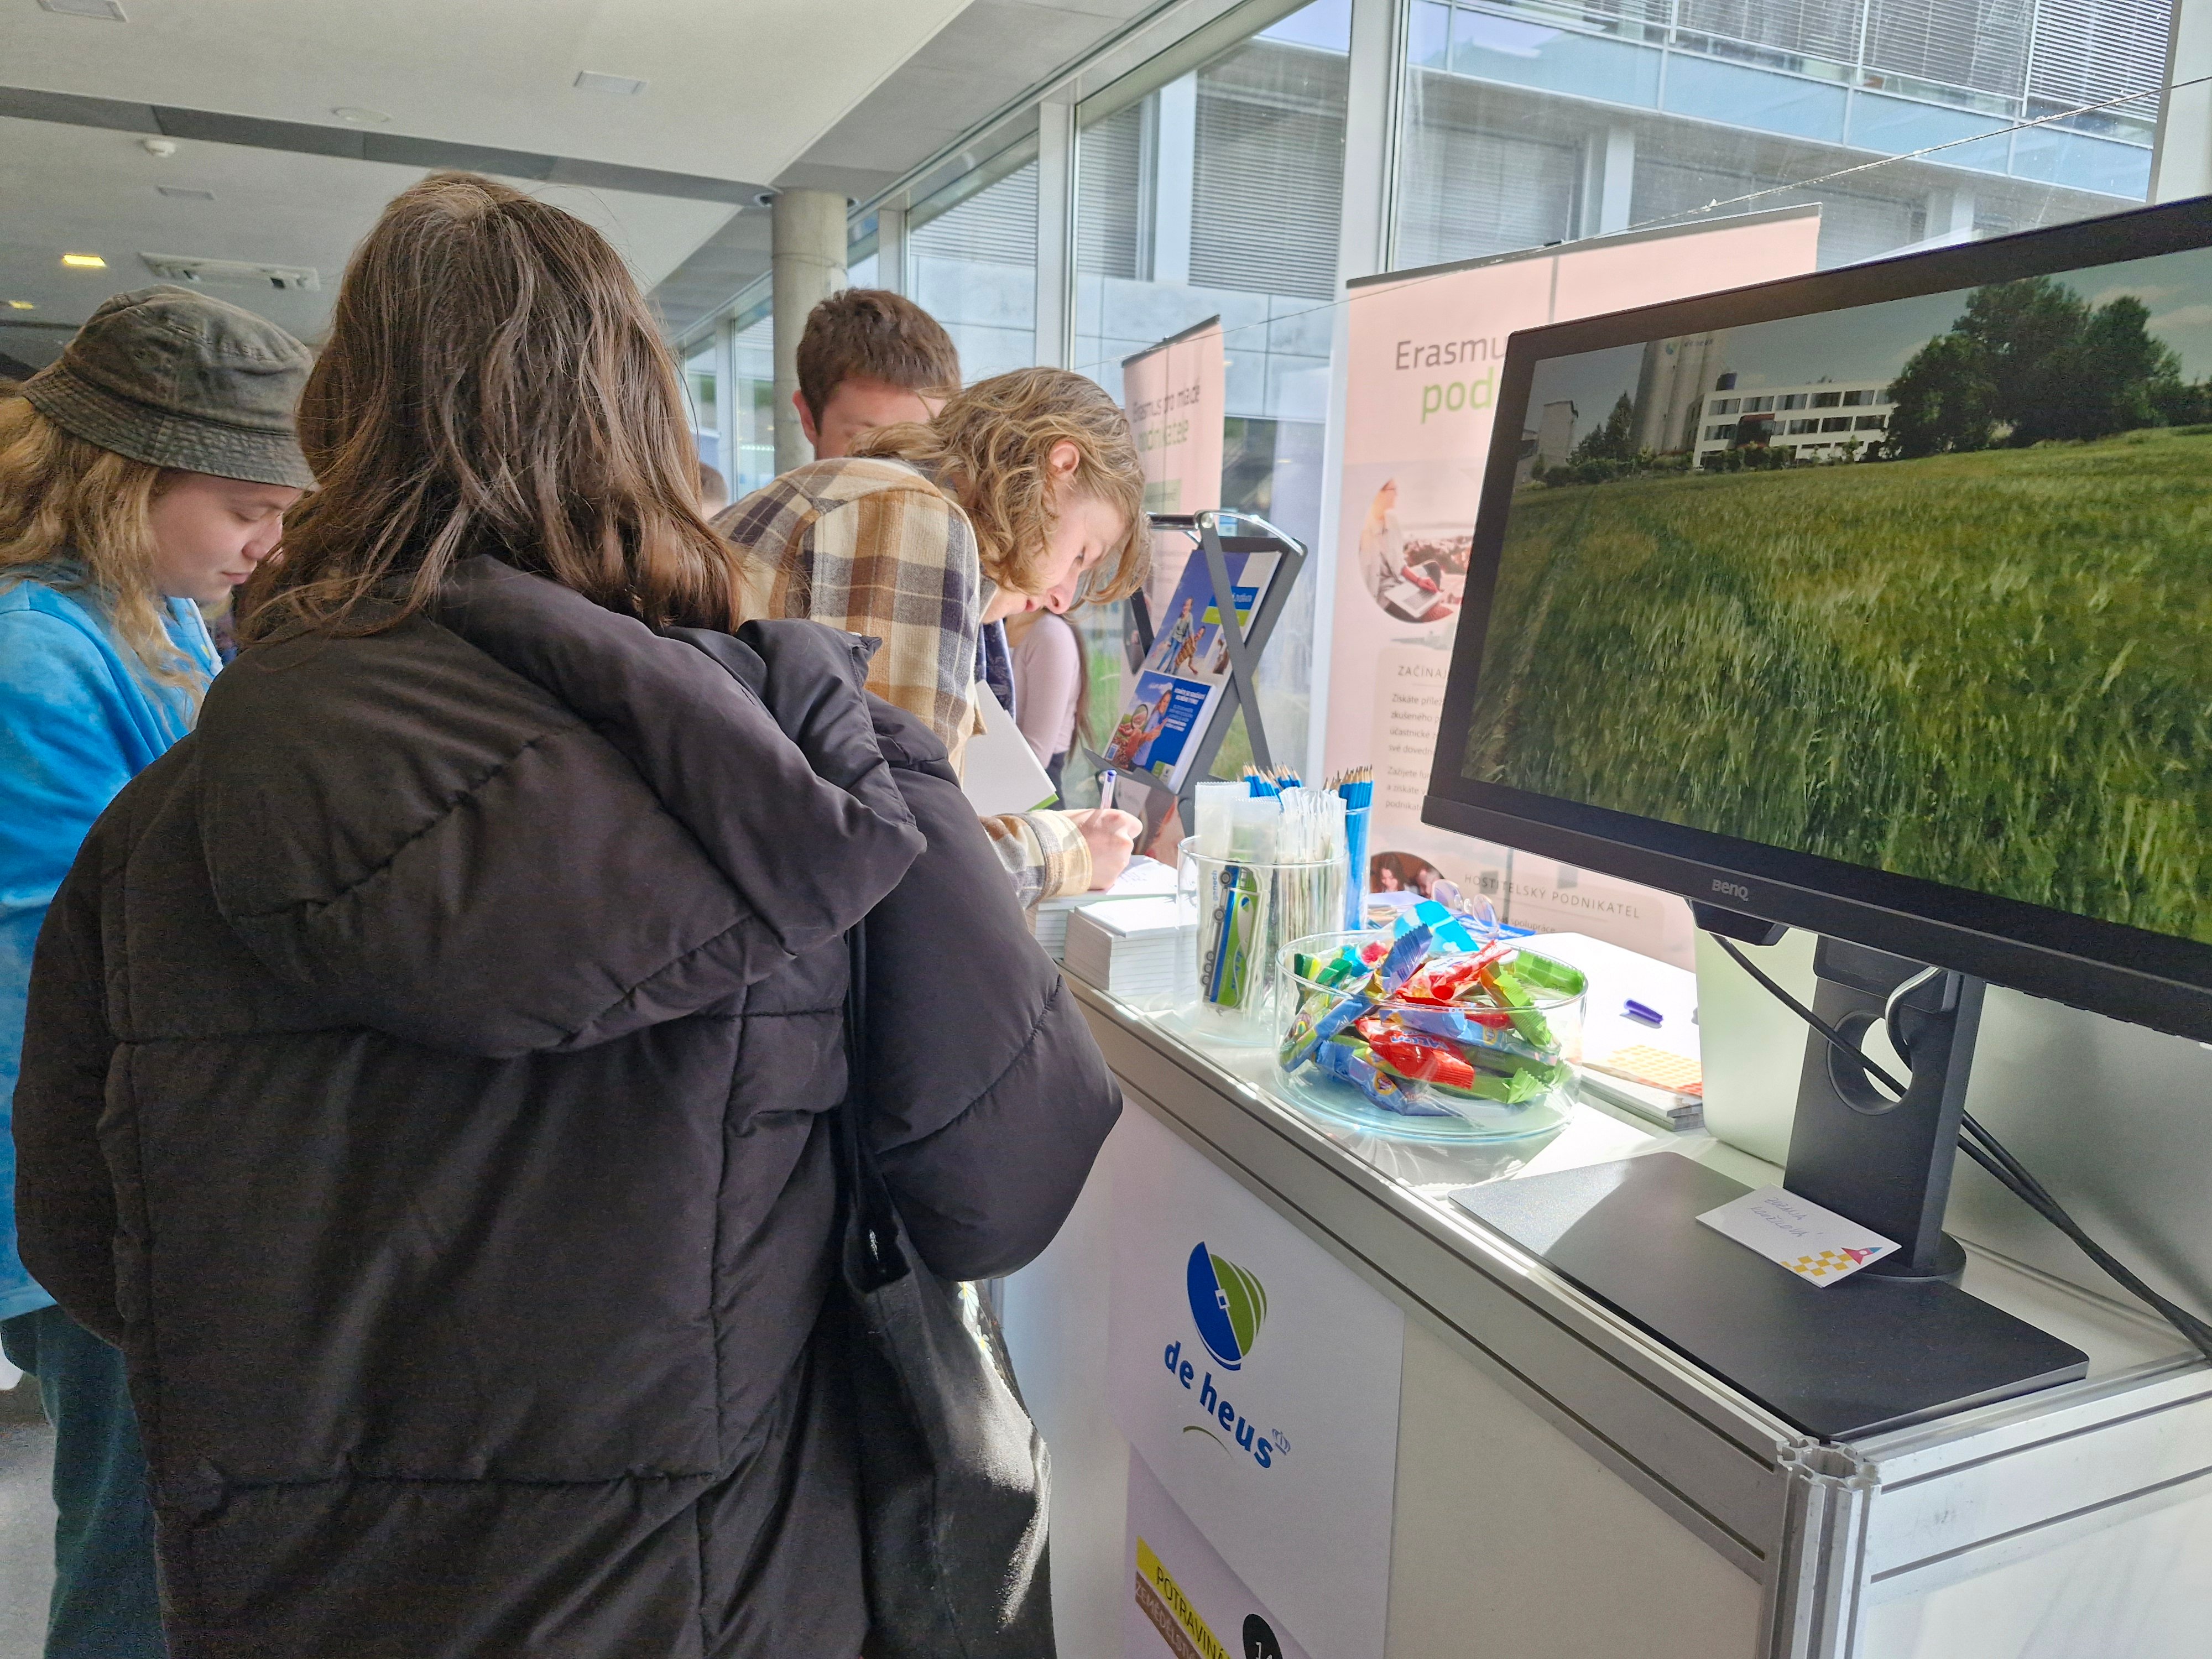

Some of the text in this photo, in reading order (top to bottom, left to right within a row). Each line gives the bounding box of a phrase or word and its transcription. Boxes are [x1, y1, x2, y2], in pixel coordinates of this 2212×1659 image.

[1396, 336, 1507, 371] Erasmu
[1421, 366, 1501, 424] pod
[1390, 710, 1432, 722] zkušeného
[1464, 873, 1641, 919] HOSTITELSKÝ PODNIKATEL
[1164, 1340, 1271, 1469] de heus
